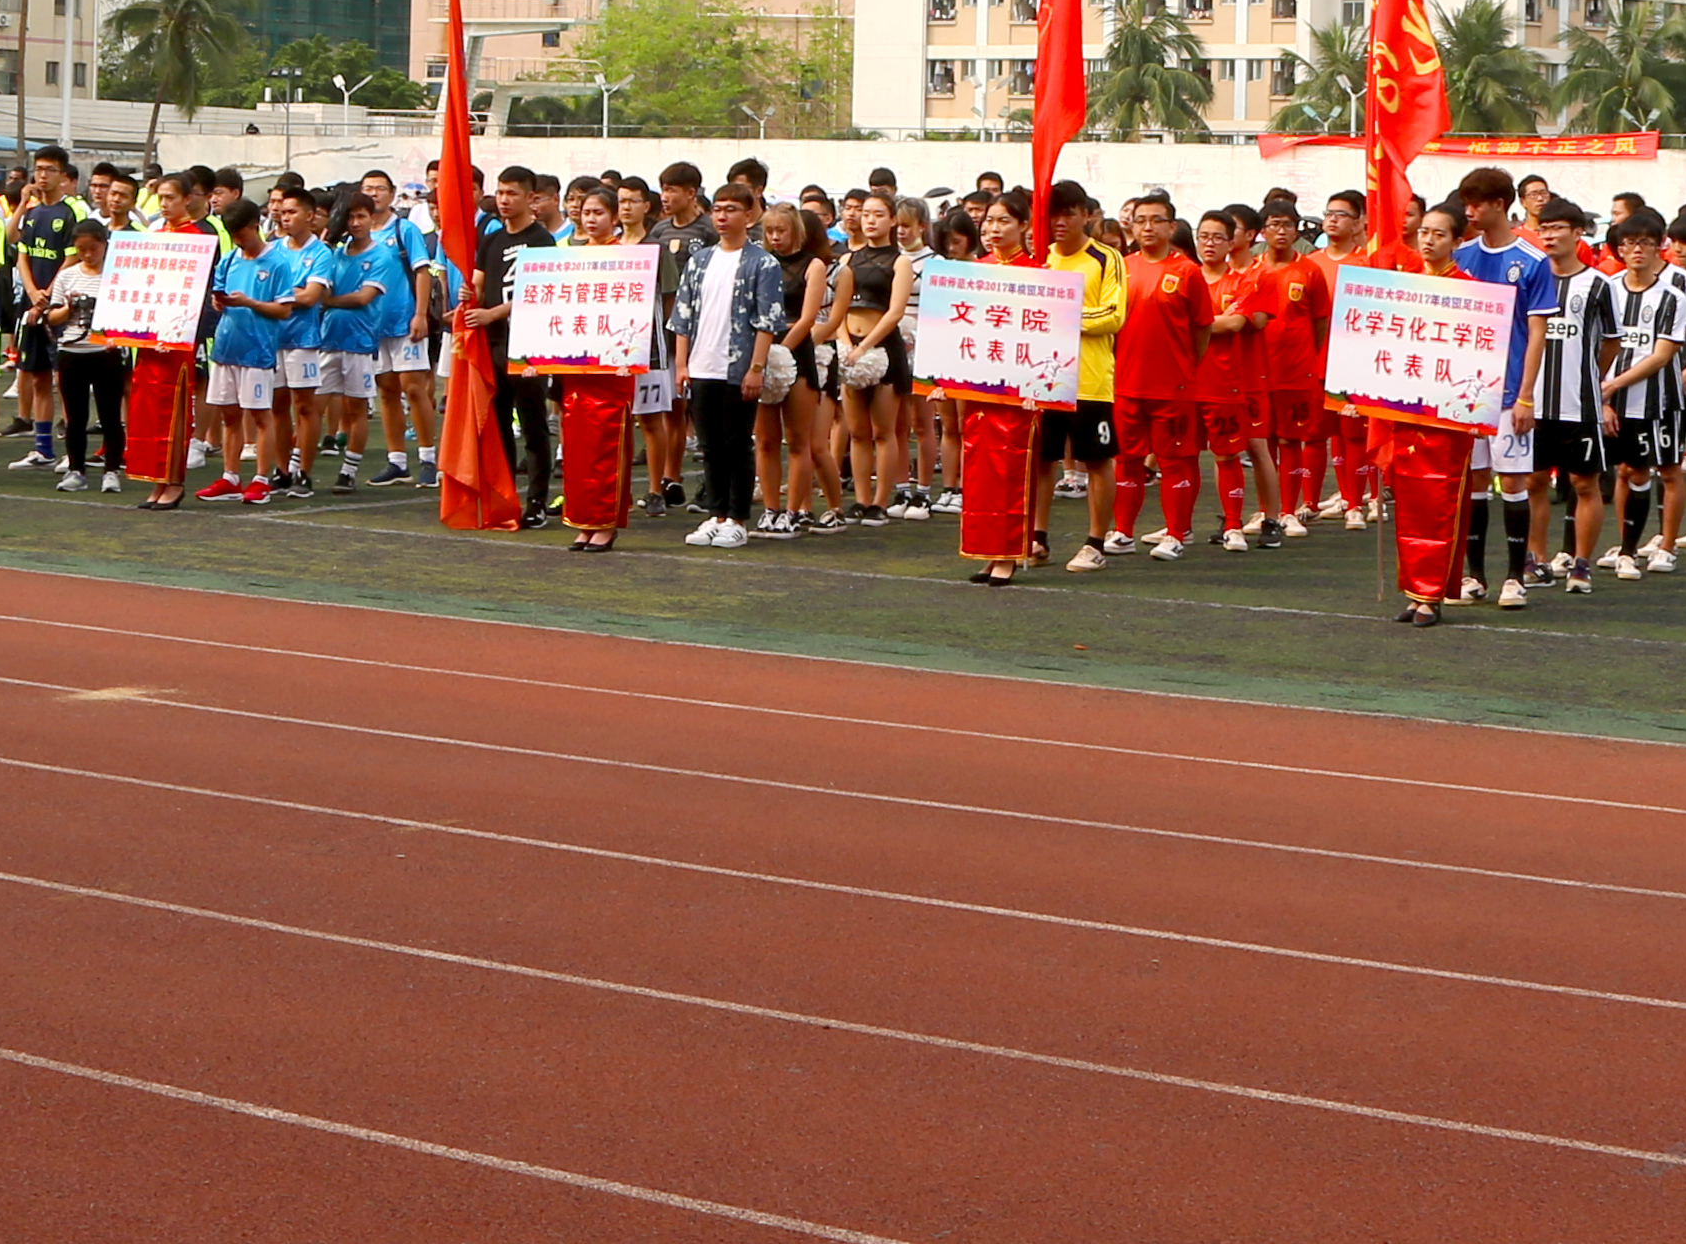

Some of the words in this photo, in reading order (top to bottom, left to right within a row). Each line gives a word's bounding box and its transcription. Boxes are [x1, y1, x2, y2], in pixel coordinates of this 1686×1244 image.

[1467, 137, 1637, 155] 抵御不正之风
[113, 255, 198, 273] 新闻传播与影视学院
[107, 289, 190, 307] 马克思主义学院
[523, 281, 645, 306] 经济与管理学院
[132, 309, 157, 323] 联队
[547, 314, 612, 337] 代表队
[949, 301, 1051, 334] 文学院
[1343, 307, 1496, 352] 化学与化工学院
[1546, 321, 1578, 339] eep
[1621, 330, 1650, 347] eep
[403, 345, 420, 361] 24
[958, 337, 1033, 366] 代表队
[302, 362, 317, 379] 10
[1373, 351, 1453, 383] 代表队
[638, 384, 661, 404] 77
[1098, 421, 1111, 445] 9
[1638, 432, 1650, 457] 5
[1658, 425, 1671, 448] 6
[1503, 433, 1531, 459] 29
[1581, 437, 1594, 462] 7
